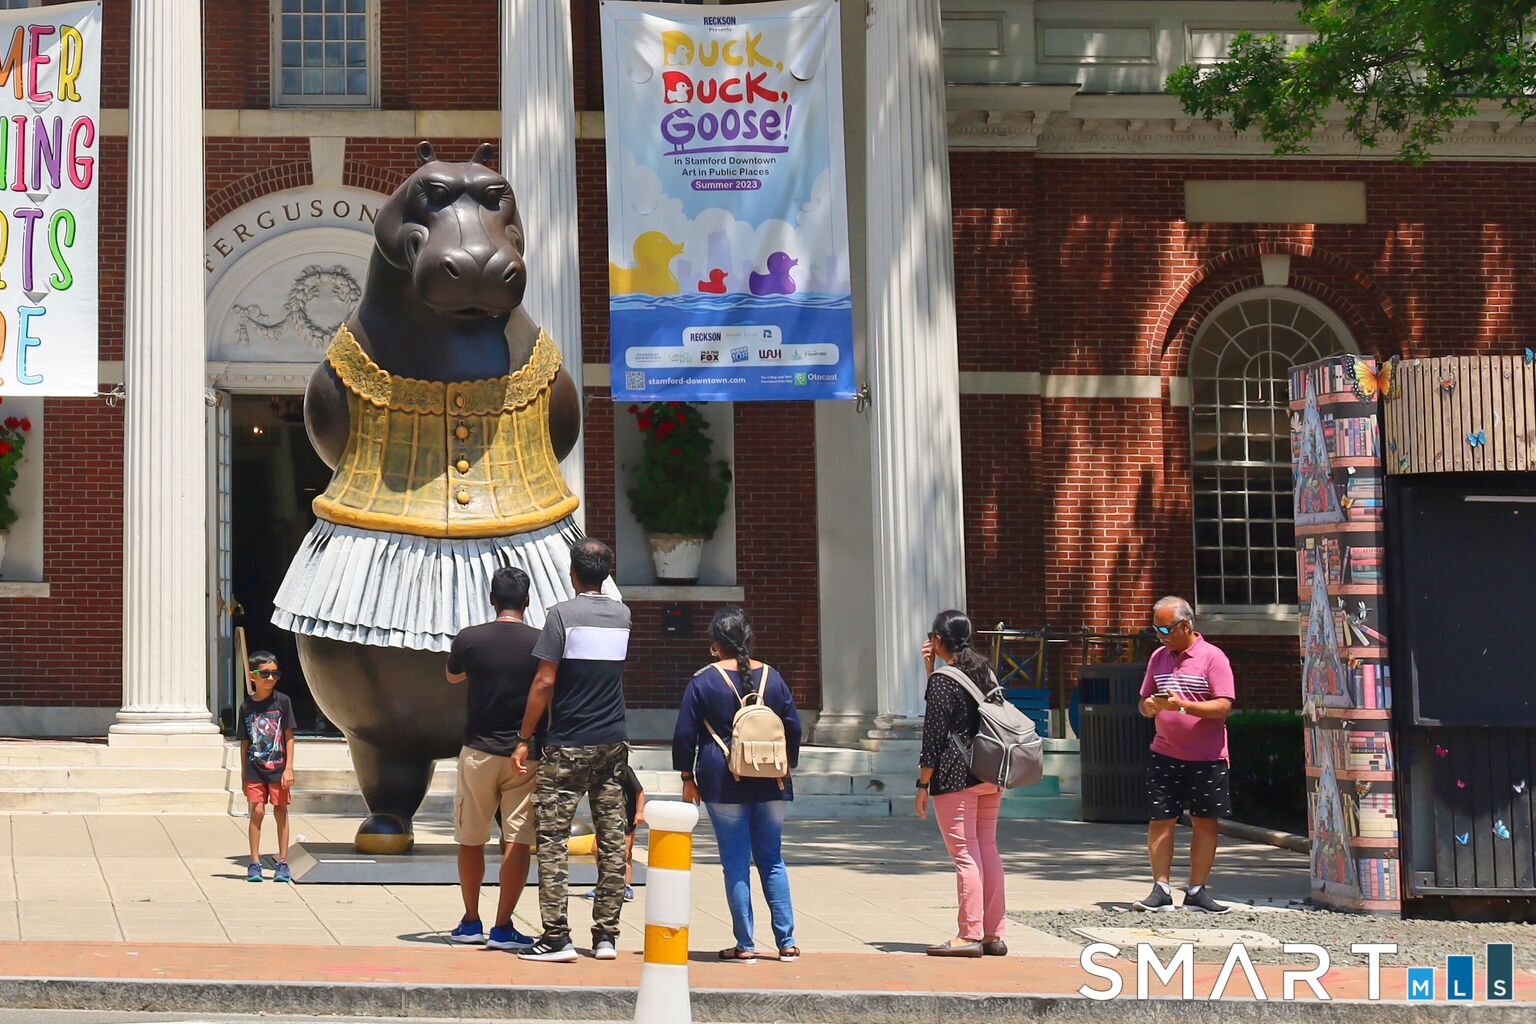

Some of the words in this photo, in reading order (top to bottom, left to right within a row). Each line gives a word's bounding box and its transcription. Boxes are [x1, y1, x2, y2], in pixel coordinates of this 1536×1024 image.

[703, 16, 736, 25] RECKSON
[674, 157, 683, 165] in
[685, 156, 727, 165] Stamford
[728, 156, 777, 165] Downtown
[682, 168, 697, 176] Art
[698, 168, 707, 176] in
[709, 168, 737, 176] Public
[739, 168, 770, 176] Places
[695, 181, 734, 189] Summer
[735, 180, 758, 189] 2023
[690, 332, 721, 342] RECKSON
[648, 377, 746, 385] stamford-downtown.com
[807, 373, 837, 381] Otocast
